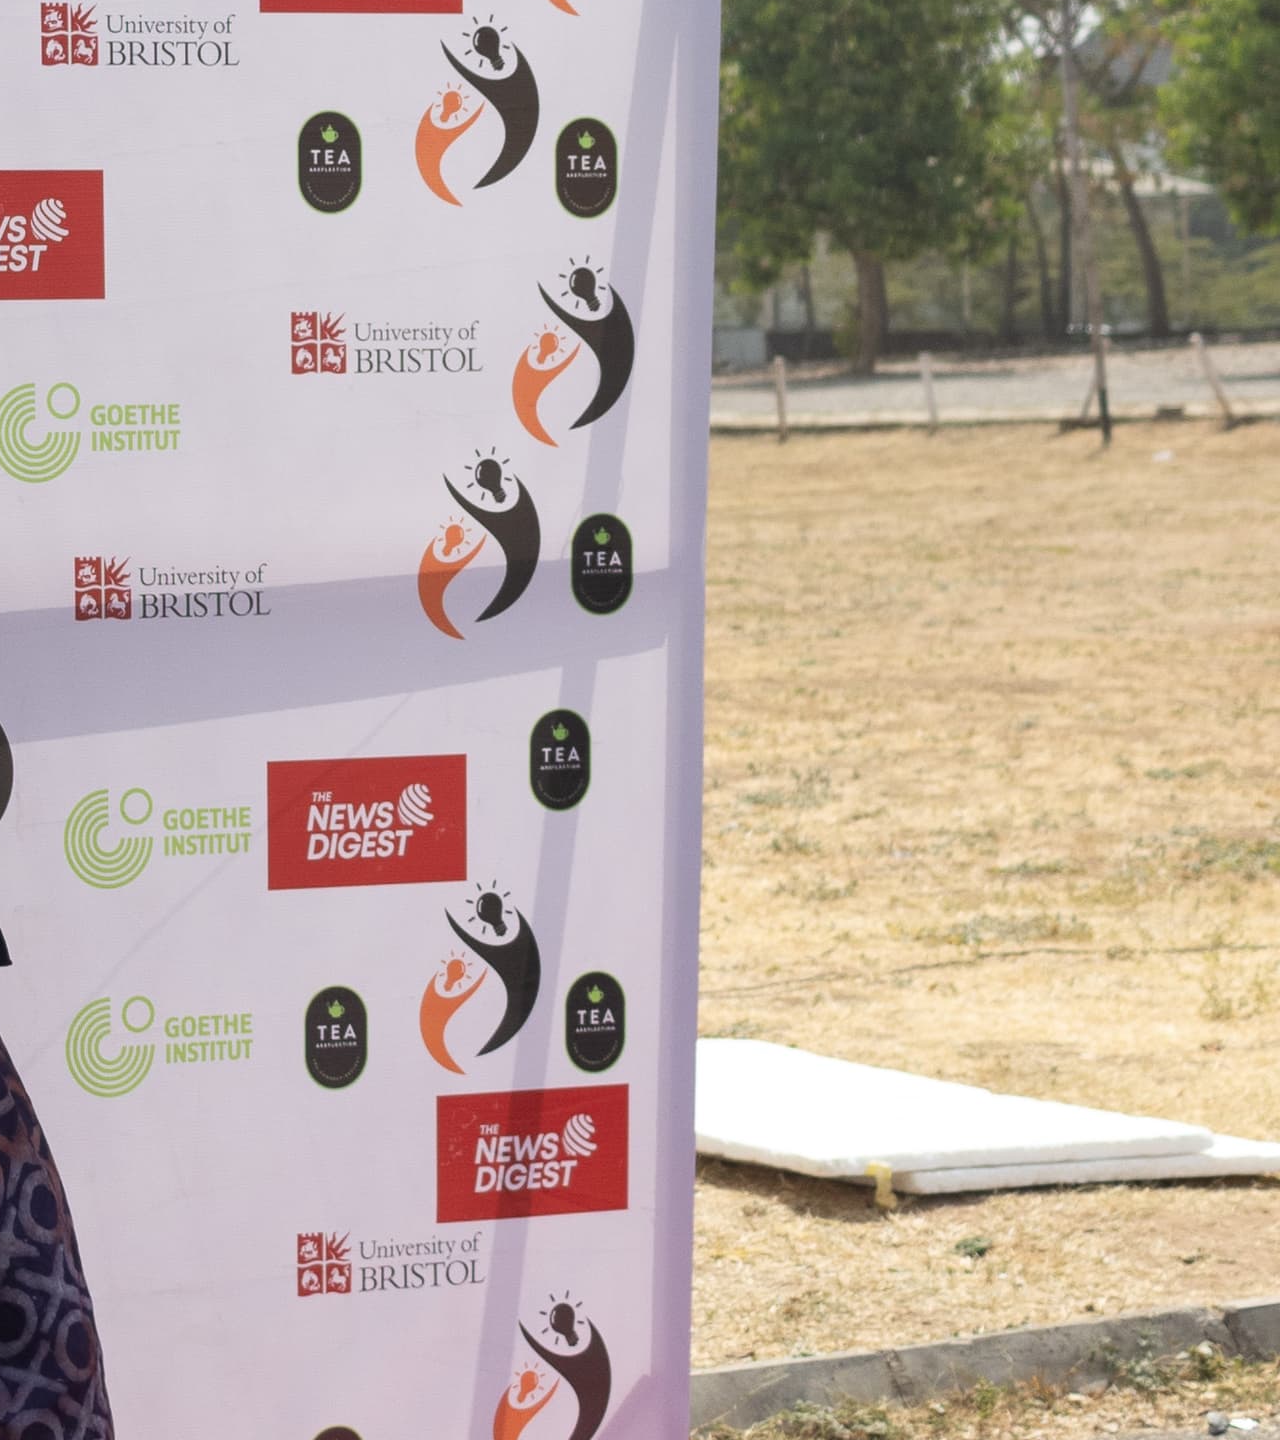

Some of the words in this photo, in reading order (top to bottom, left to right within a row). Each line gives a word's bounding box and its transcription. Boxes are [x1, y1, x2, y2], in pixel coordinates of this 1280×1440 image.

[107, 15, 207, 38] University
[213, 15, 232, 34] of
[108, 36, 239, 65] BRISTOL
[311, 150, 350, 164] TEA
[568, 155, 606, 170] TEA
[355, 323, 452, 345] University
[458, 321, 479, 339] of
[355, 348, 481, 373] BRISTOL
[90, 404, 180, 426] GOETHE
[92, 430, 180, 451] INSTITUT
[584, 551, 621, 566] TEA
[542, 747, 579, 762] TEA
[163, 807, 251, 831] GOETHE
[164, 832, 251, 856] INSTITUT
[164, 1013, 252, 1038] GOETHE
[577, 1009, 614, 1024] TEA
[317, 1024, 356, 1040] TEA
[166, 1039, 253, 1064] INSTITUT
[481, 1125, 498, 1134] THE
[475, 1131, 558, 1163] NEWS
[475, 1160, 577, 1192] DIGEST
[360, 1241, 457, 1262] University
[461, 1232, 481, 1252] of
[360, 1256, 483, 1292] BRISTOL
